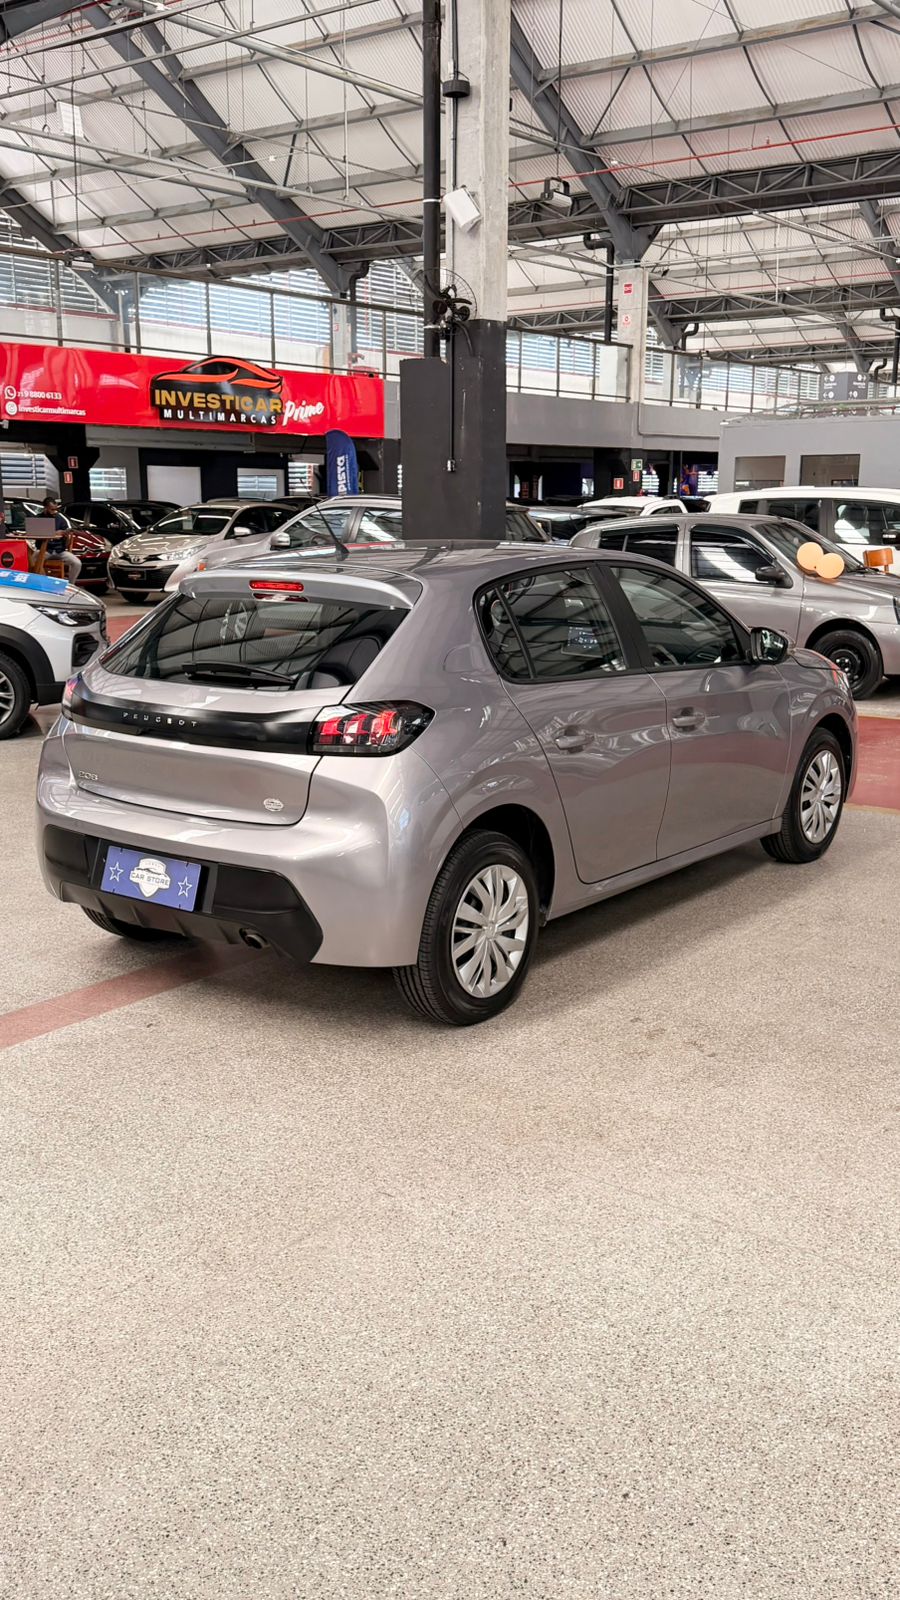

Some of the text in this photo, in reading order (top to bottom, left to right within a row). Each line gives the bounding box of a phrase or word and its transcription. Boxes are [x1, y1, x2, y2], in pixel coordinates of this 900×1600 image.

[154, 389, 282, 413] INVESTICAR
[163, 408, 277, 425] MULTIMARCAS
[282, 400, 325, 426] Prime
[123, 711, 197, 727] PEUGEOT
[131, 872, 169, 886] CAR STORE
